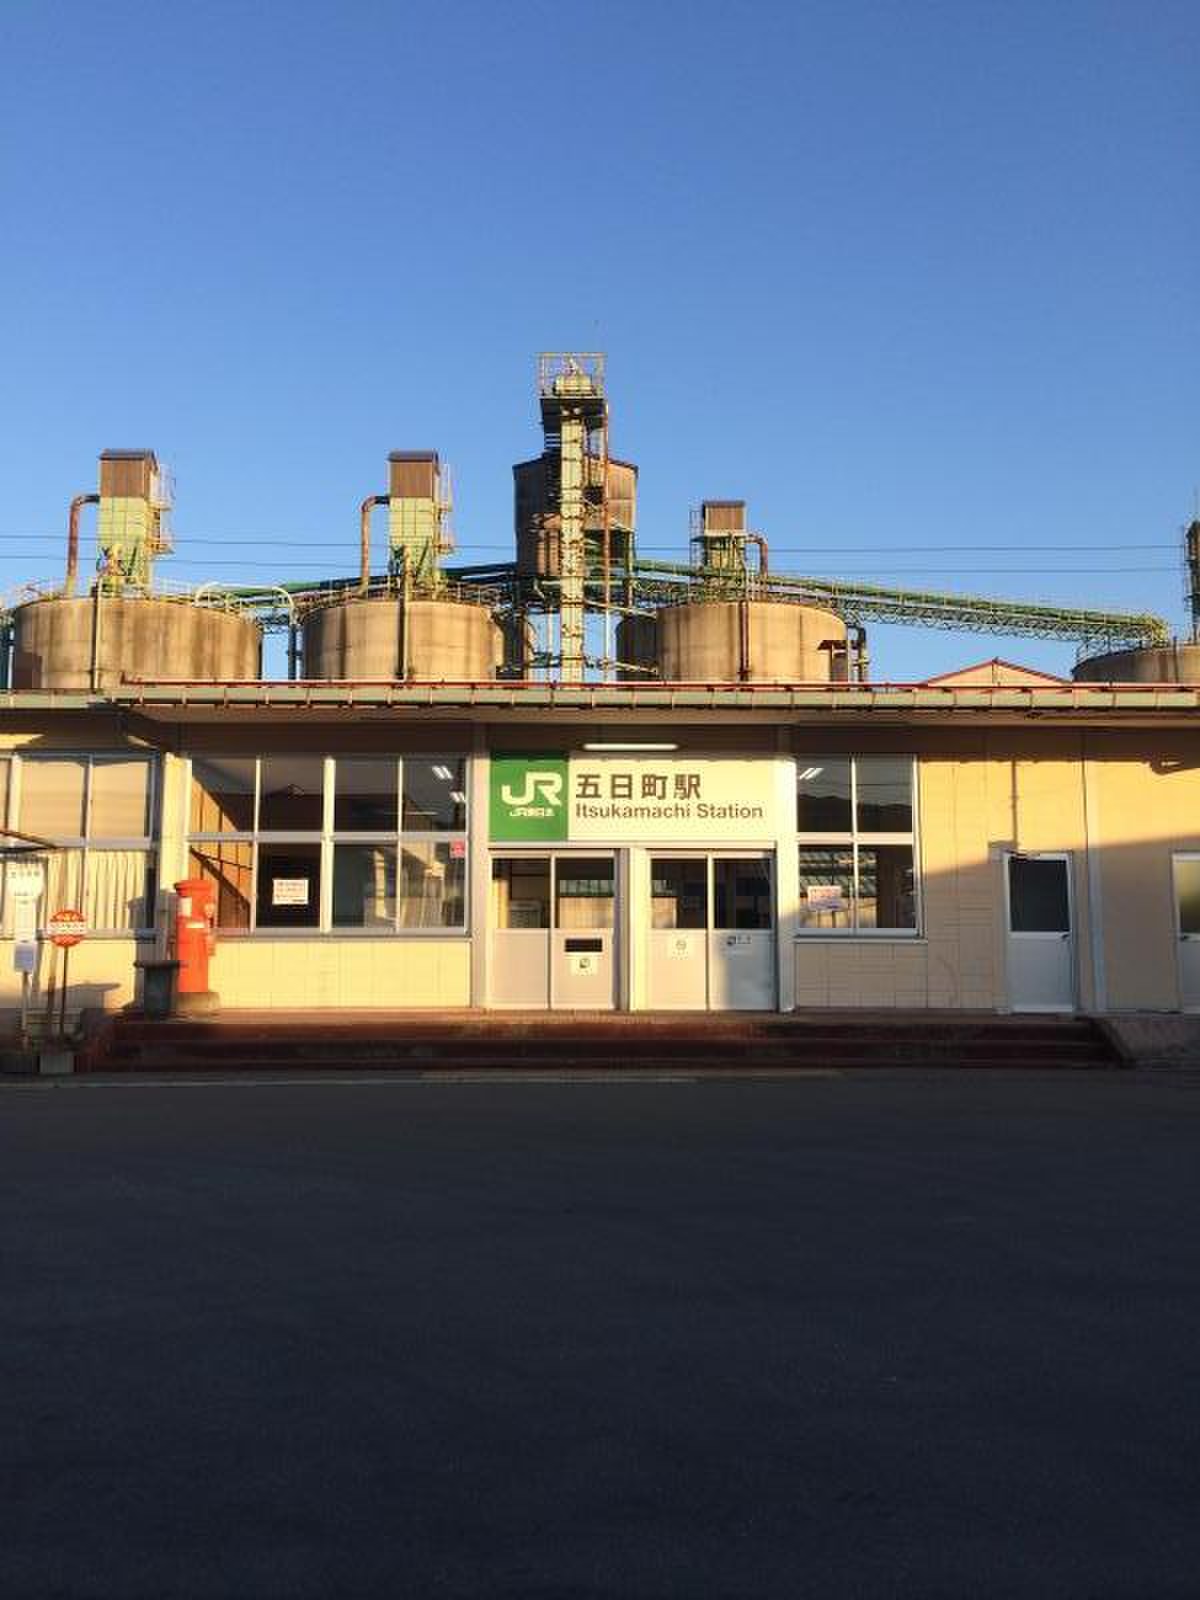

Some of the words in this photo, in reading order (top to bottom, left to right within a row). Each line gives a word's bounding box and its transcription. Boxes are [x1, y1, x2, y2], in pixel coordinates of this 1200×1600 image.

[502, 772, 562, 806] JR
[576, 774, 701, 799] 五日町駅
[576, 803, 690, 818] Itsukamachi
[696, 803, 763, 818] Station
